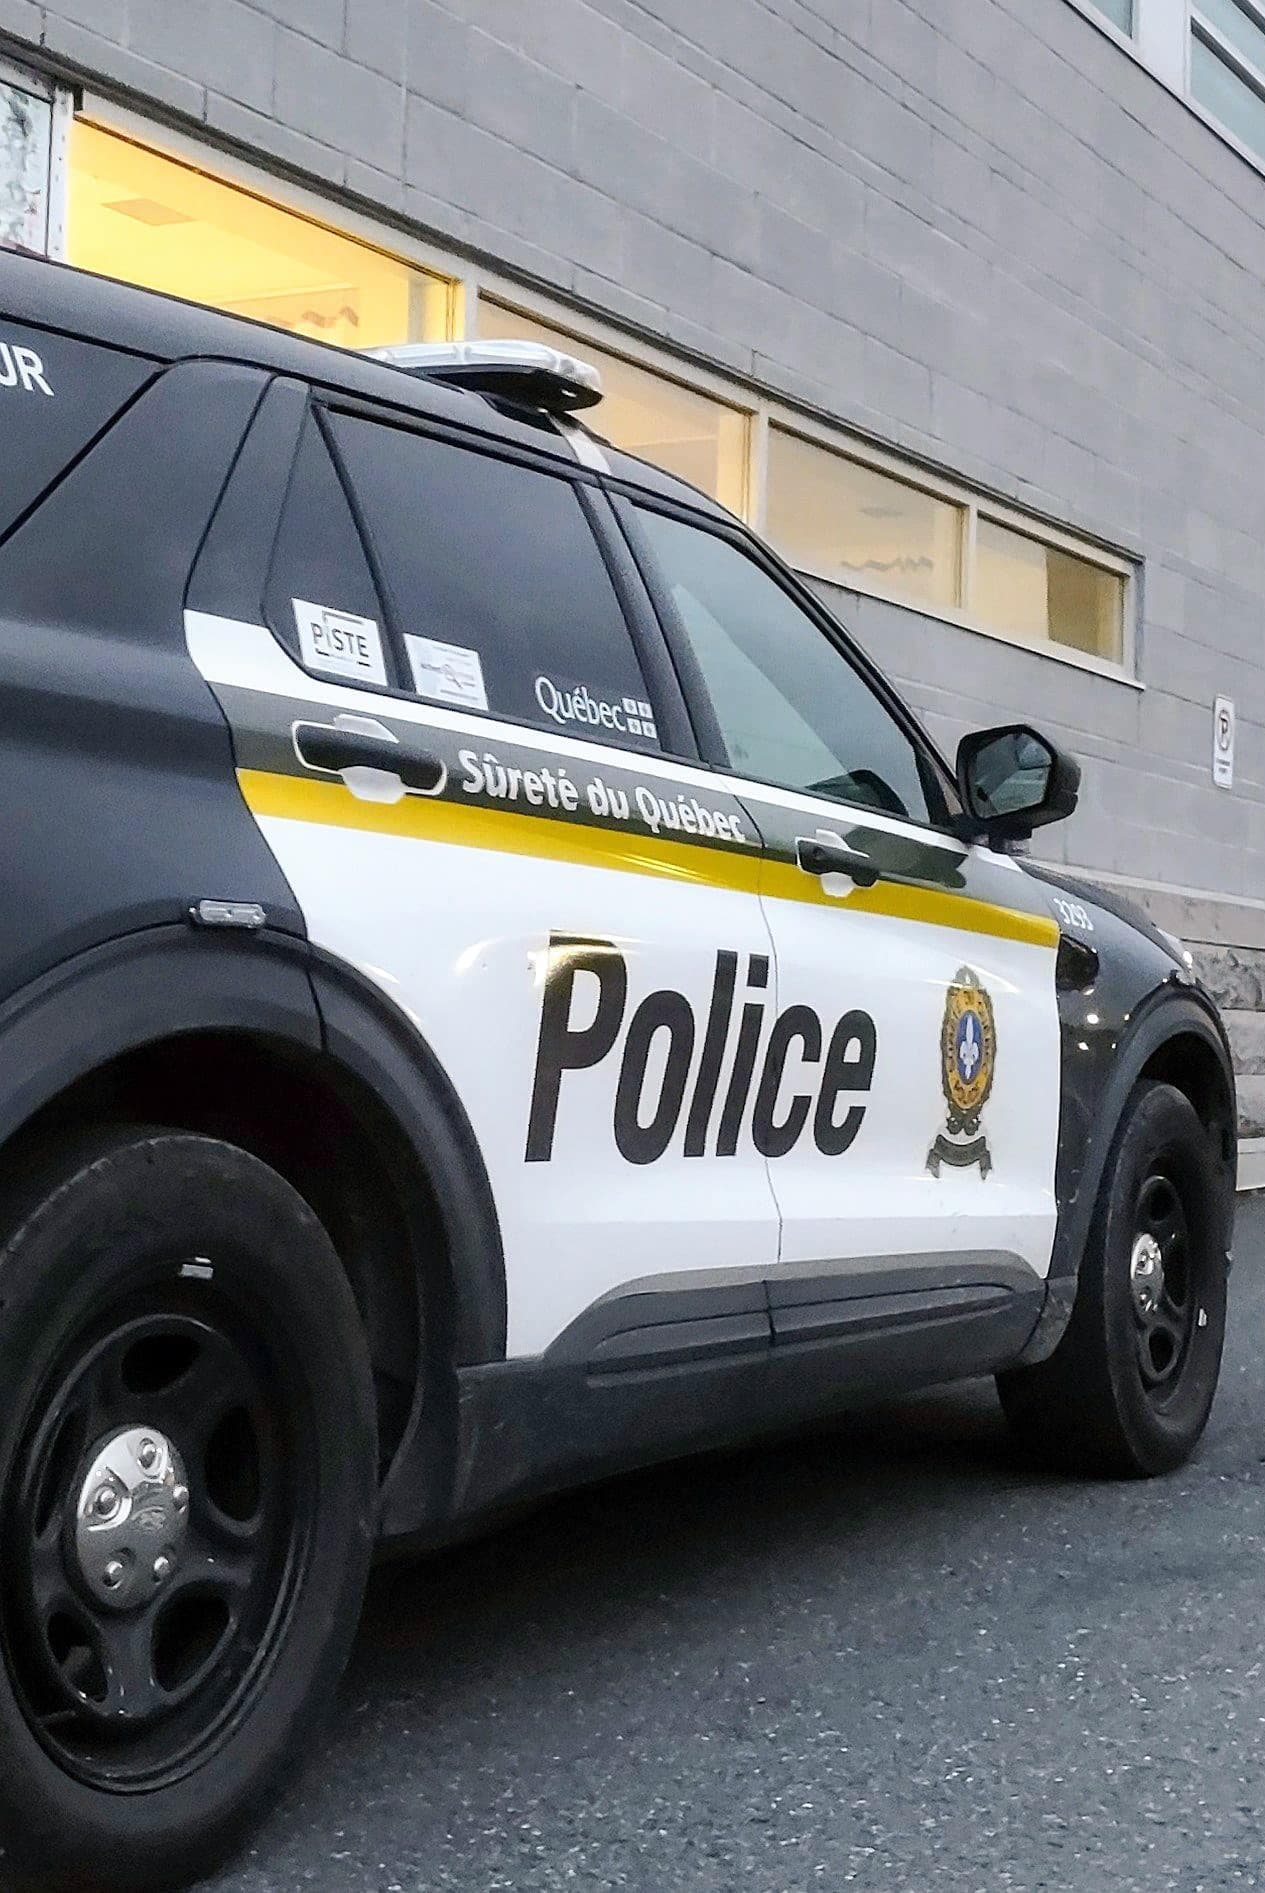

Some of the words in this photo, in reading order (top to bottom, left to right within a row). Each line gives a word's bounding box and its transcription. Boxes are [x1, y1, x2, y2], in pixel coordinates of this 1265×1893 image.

[535, 676, 627, 732] Québec
[458, 750, 578, 811] Sûreté
[587, 778, 630, 820] du
[635, 787, 746, 842] Québec
[524, 929, 877, 1165] Police
